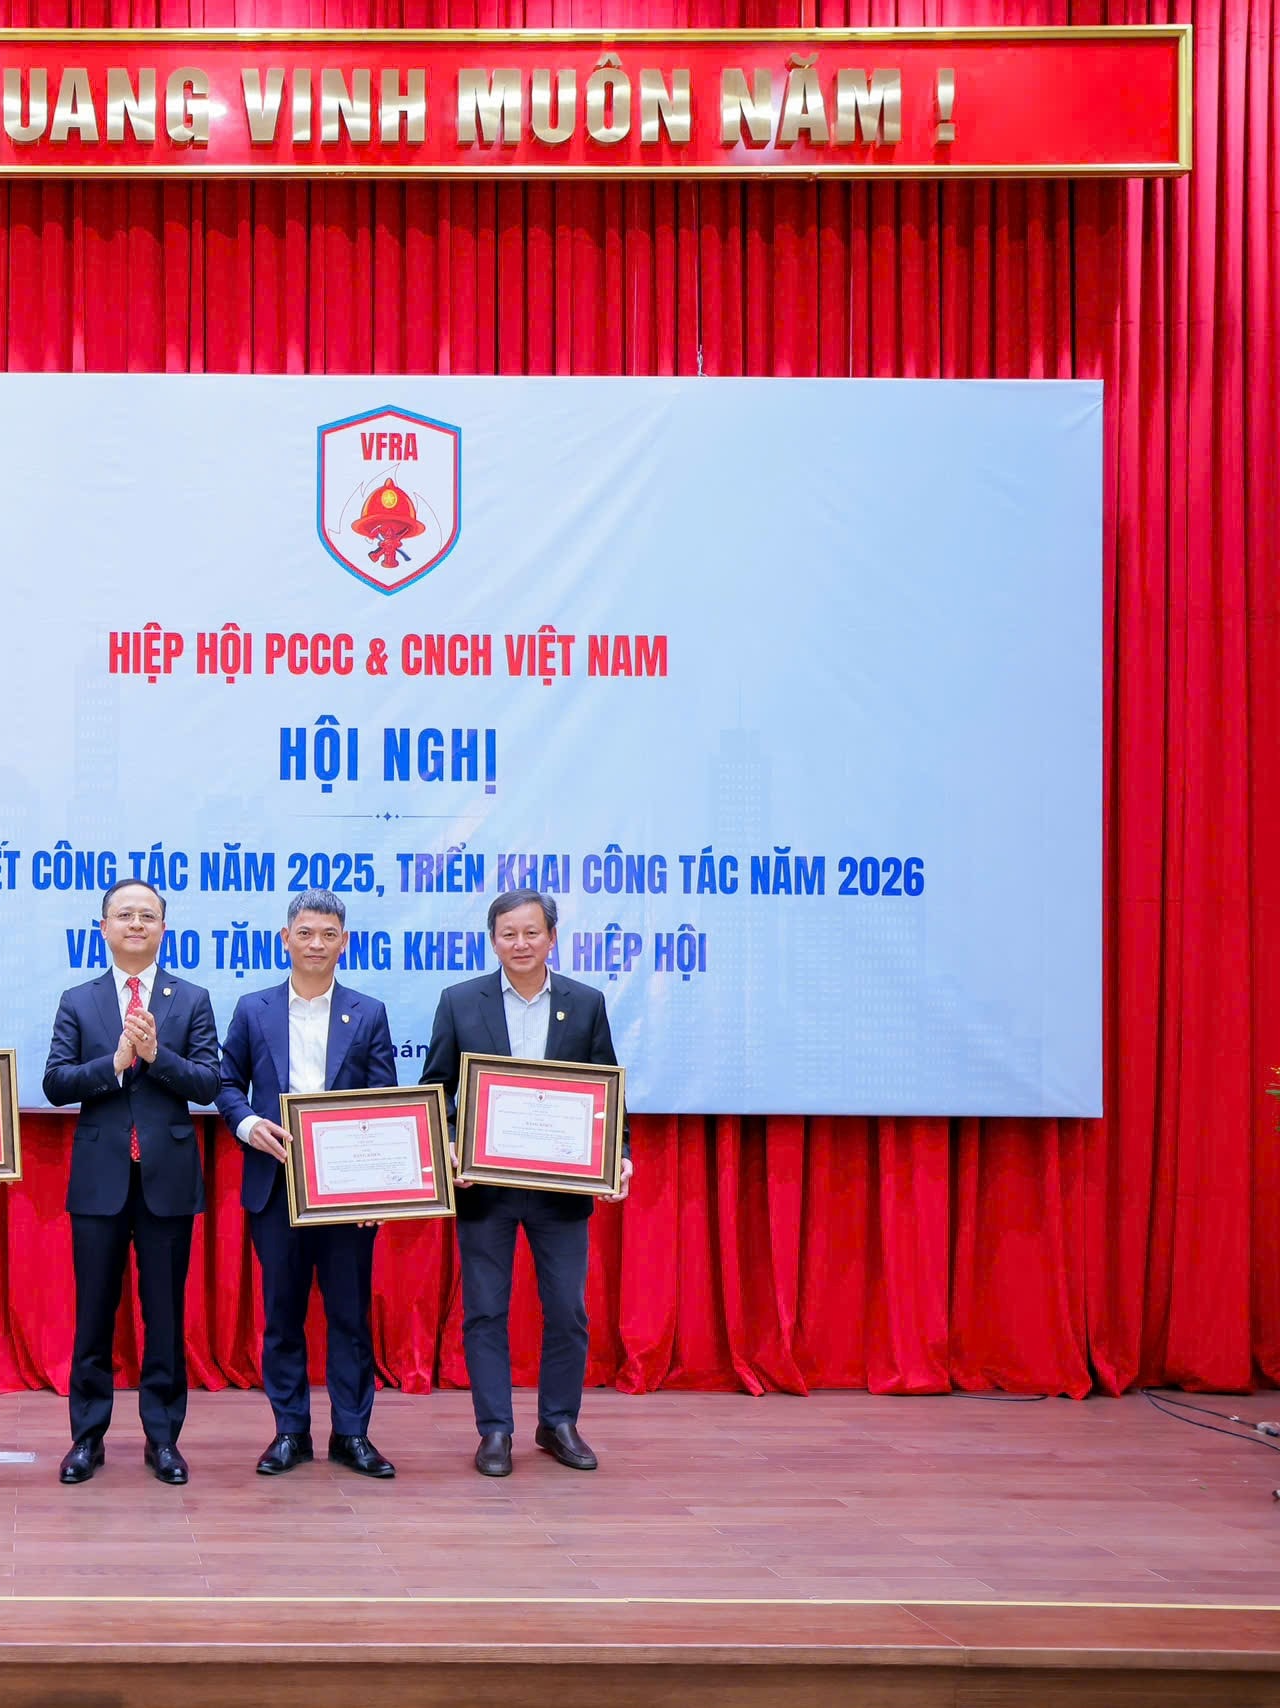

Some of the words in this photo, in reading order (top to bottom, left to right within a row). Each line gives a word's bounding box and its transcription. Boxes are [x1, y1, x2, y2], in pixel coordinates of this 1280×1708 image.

[241, 67, 426, 144] VINH
[458, 52, 691, 145] MUÔN
[723, 52, 901, 147] NĂM
[934, 67, 956, 144] !
[361, 432, 418, 461] VFRA
[109, 622, 183, 684] HIỆP
[197, 623, 252, 684] HỘI
[266, 633, 354, 676] PCCC
[366, 638, 389, 676] &
[402, 634, 492, 676] CNCH
[506, 625, 576, 686] VIỆT
[589, 635, 668, 677] NAM
[280, 714, 359, 794] HỘI
[383, 727, 497, 795] NGHỊ
[32, 840, 117, 891] CÔNG
[128, 842, 189, 892] TÁC
[200, 842, 276, 892] NĂM
[287, 852, 385, 897] 2025,
[396, 842, 485, 893] TRIỂN
[497, 854, 571, 893] KHAI
[582, 843, 668, 895] CÔNG
[679, 846, 739, 896] TÁC
[750, 846, 826, 896] NĂM
[838, 855, 925, 897] 2026
[66, 919, 107, 969] VÀ
[158, 930, 200, 970] AO
[404, 931, 486, 972] KHEN
[573, 923, 643, 981] HIỆP
[654, 923, 707, 982] HỘI
